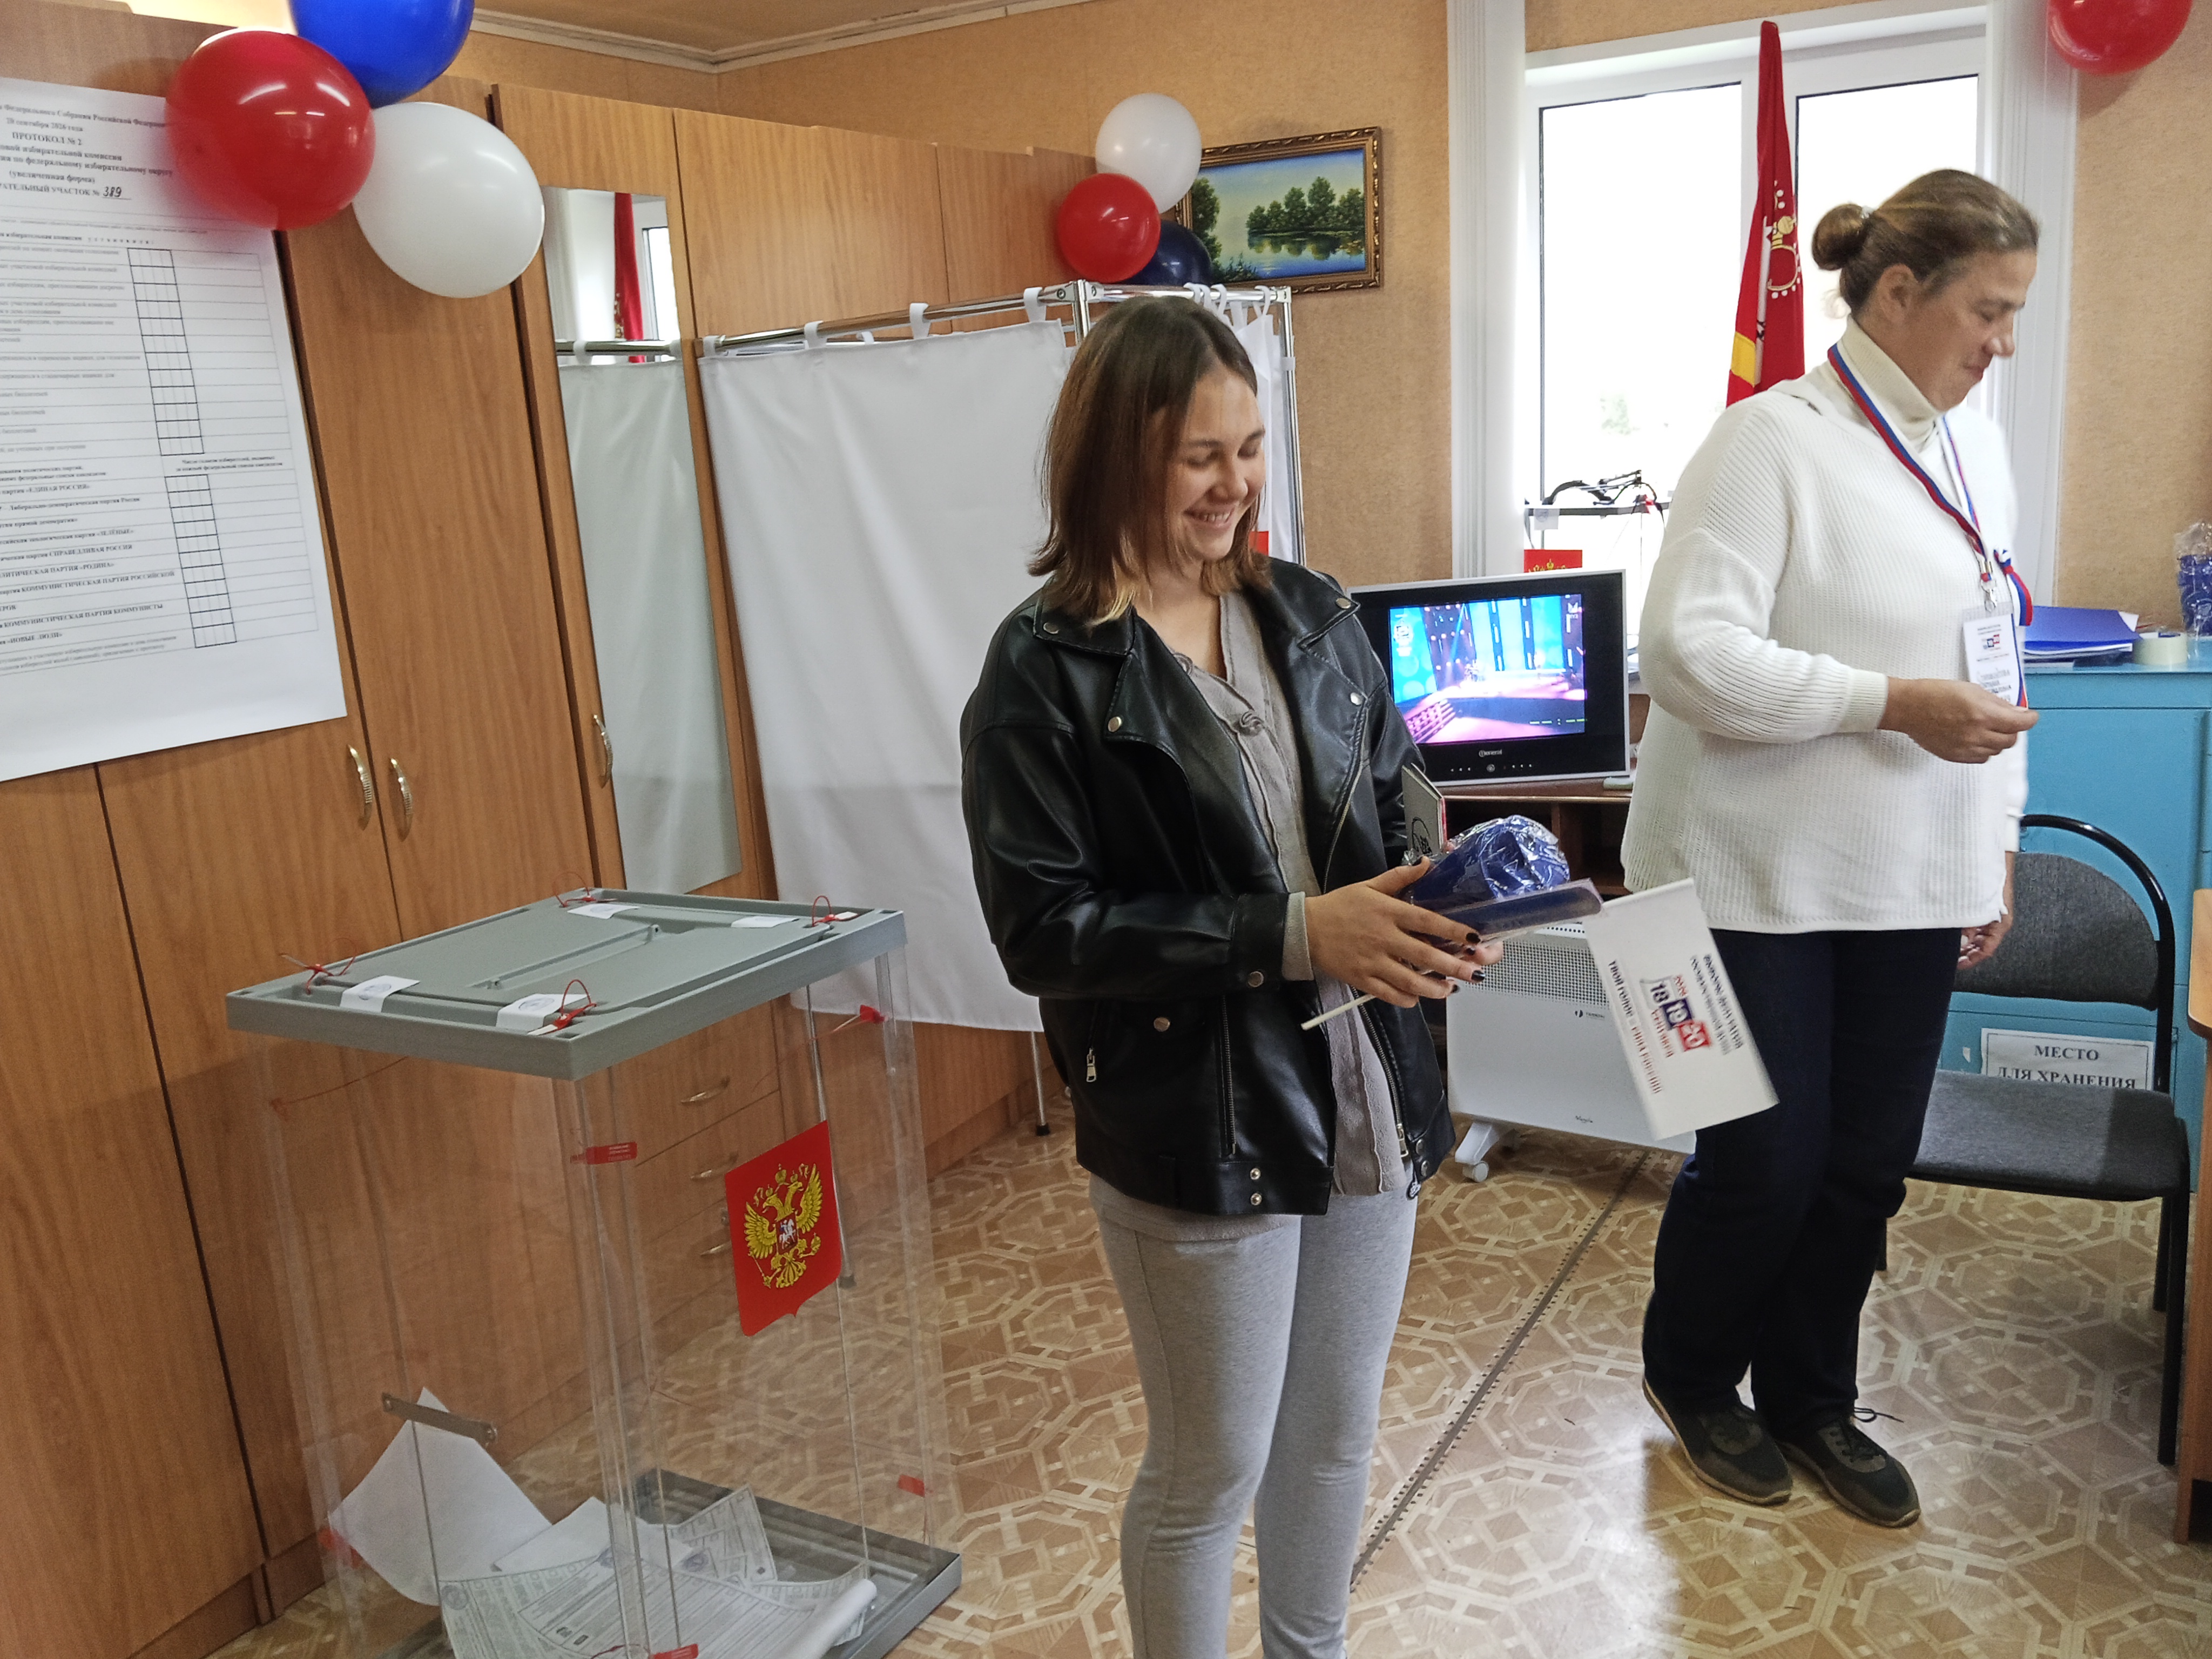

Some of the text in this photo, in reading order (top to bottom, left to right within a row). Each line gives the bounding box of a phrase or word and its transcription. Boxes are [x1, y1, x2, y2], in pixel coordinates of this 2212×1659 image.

[12, 132, 65, 144] ПРОТОКОЛ
[1650, 983, 1669, 1002] 18
[1666, 1003, 1688, 1024] 19
[2034, 1045, 2100, 1061] МЕСТО
[2038, 1070, 2136, 1089] ХРАНЕНИЯ
